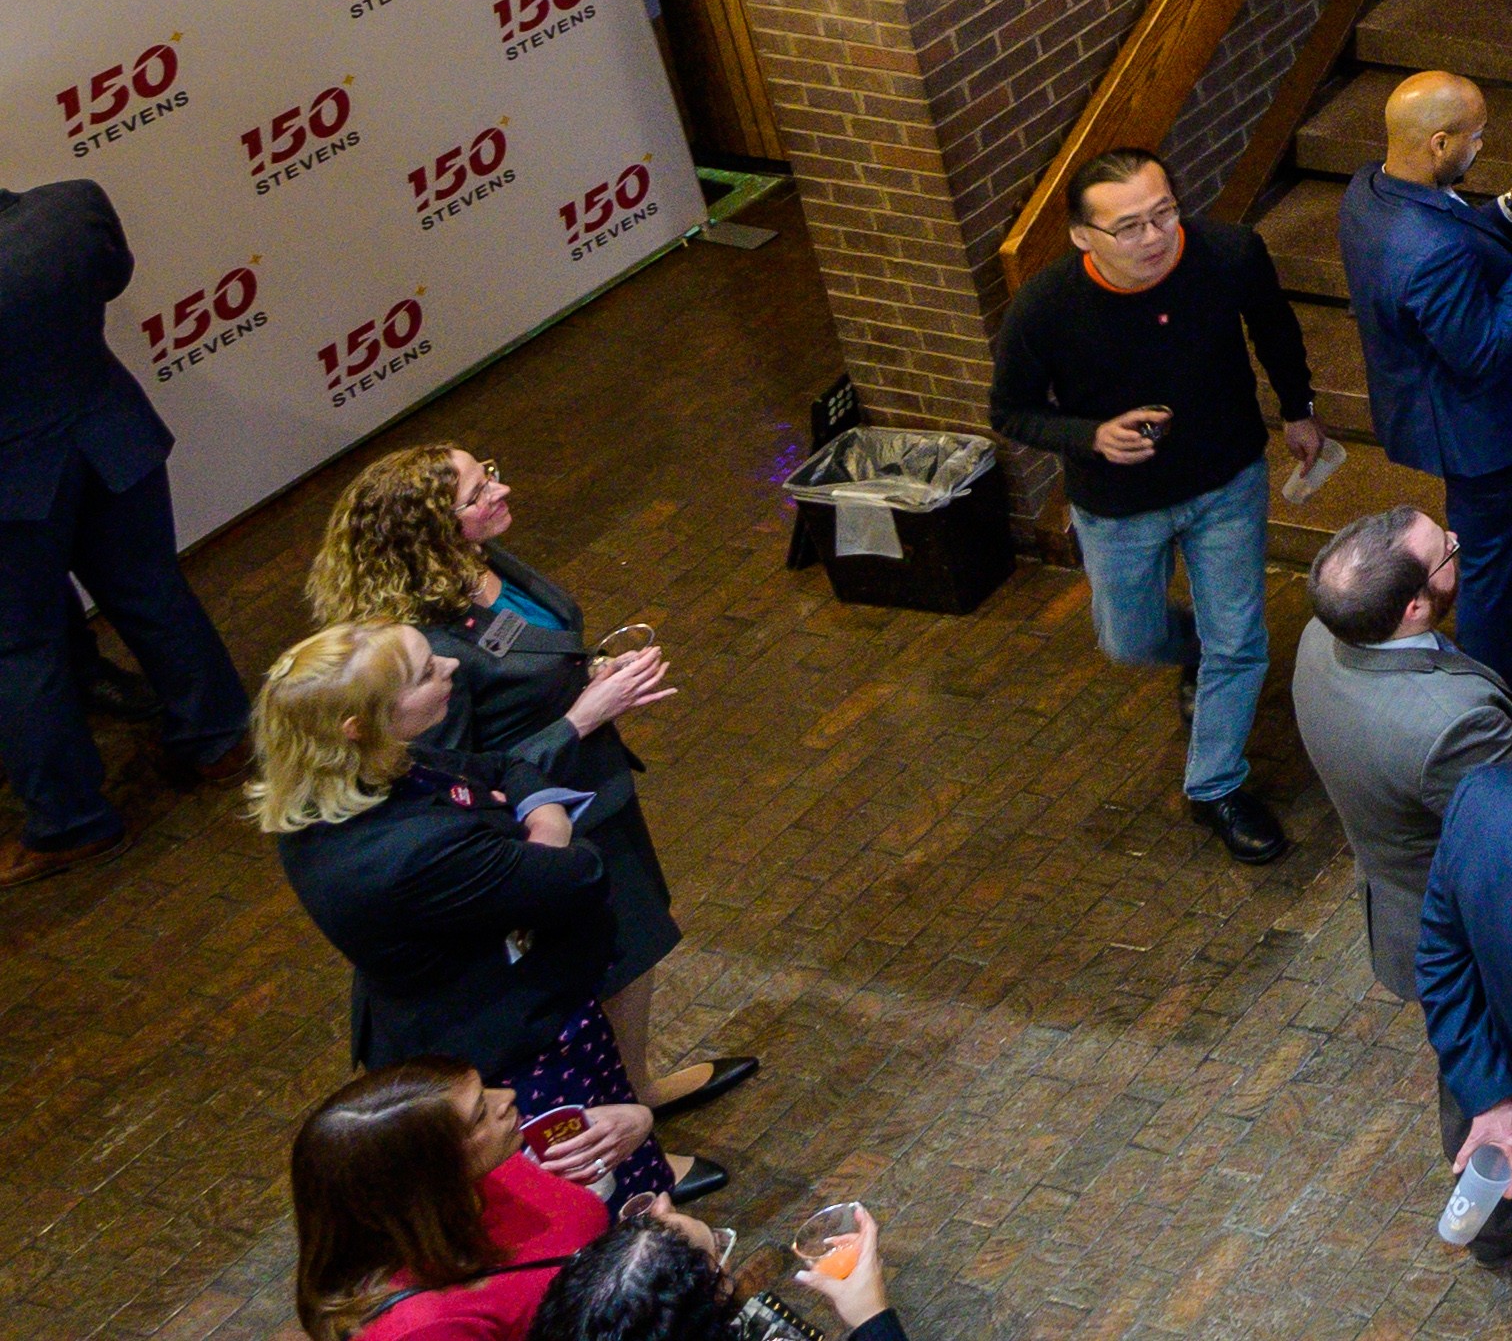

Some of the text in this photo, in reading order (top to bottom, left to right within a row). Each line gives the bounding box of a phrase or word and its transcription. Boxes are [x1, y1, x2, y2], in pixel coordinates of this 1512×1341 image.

[506, 6, 595, 60] STEVENS
[57, 45, 177, 137] 150
[73, 92, 188, 157] STEVENS
[242, 88, 349, 175] 150
[256, 132, 359, 195] STEVENS
[409, 129, 506, 211] 150
[422, 170, 515, 230] STEVENS
[560, 165, 649, 243] 150
[572, 203, 657, 261] STEVENS
[142, 268, 256, 362] 150
[157, 312, 267, 382] STEVENS
[318, 299, 421, 389] 150
[333, 340, 431, 407] STEVENS
